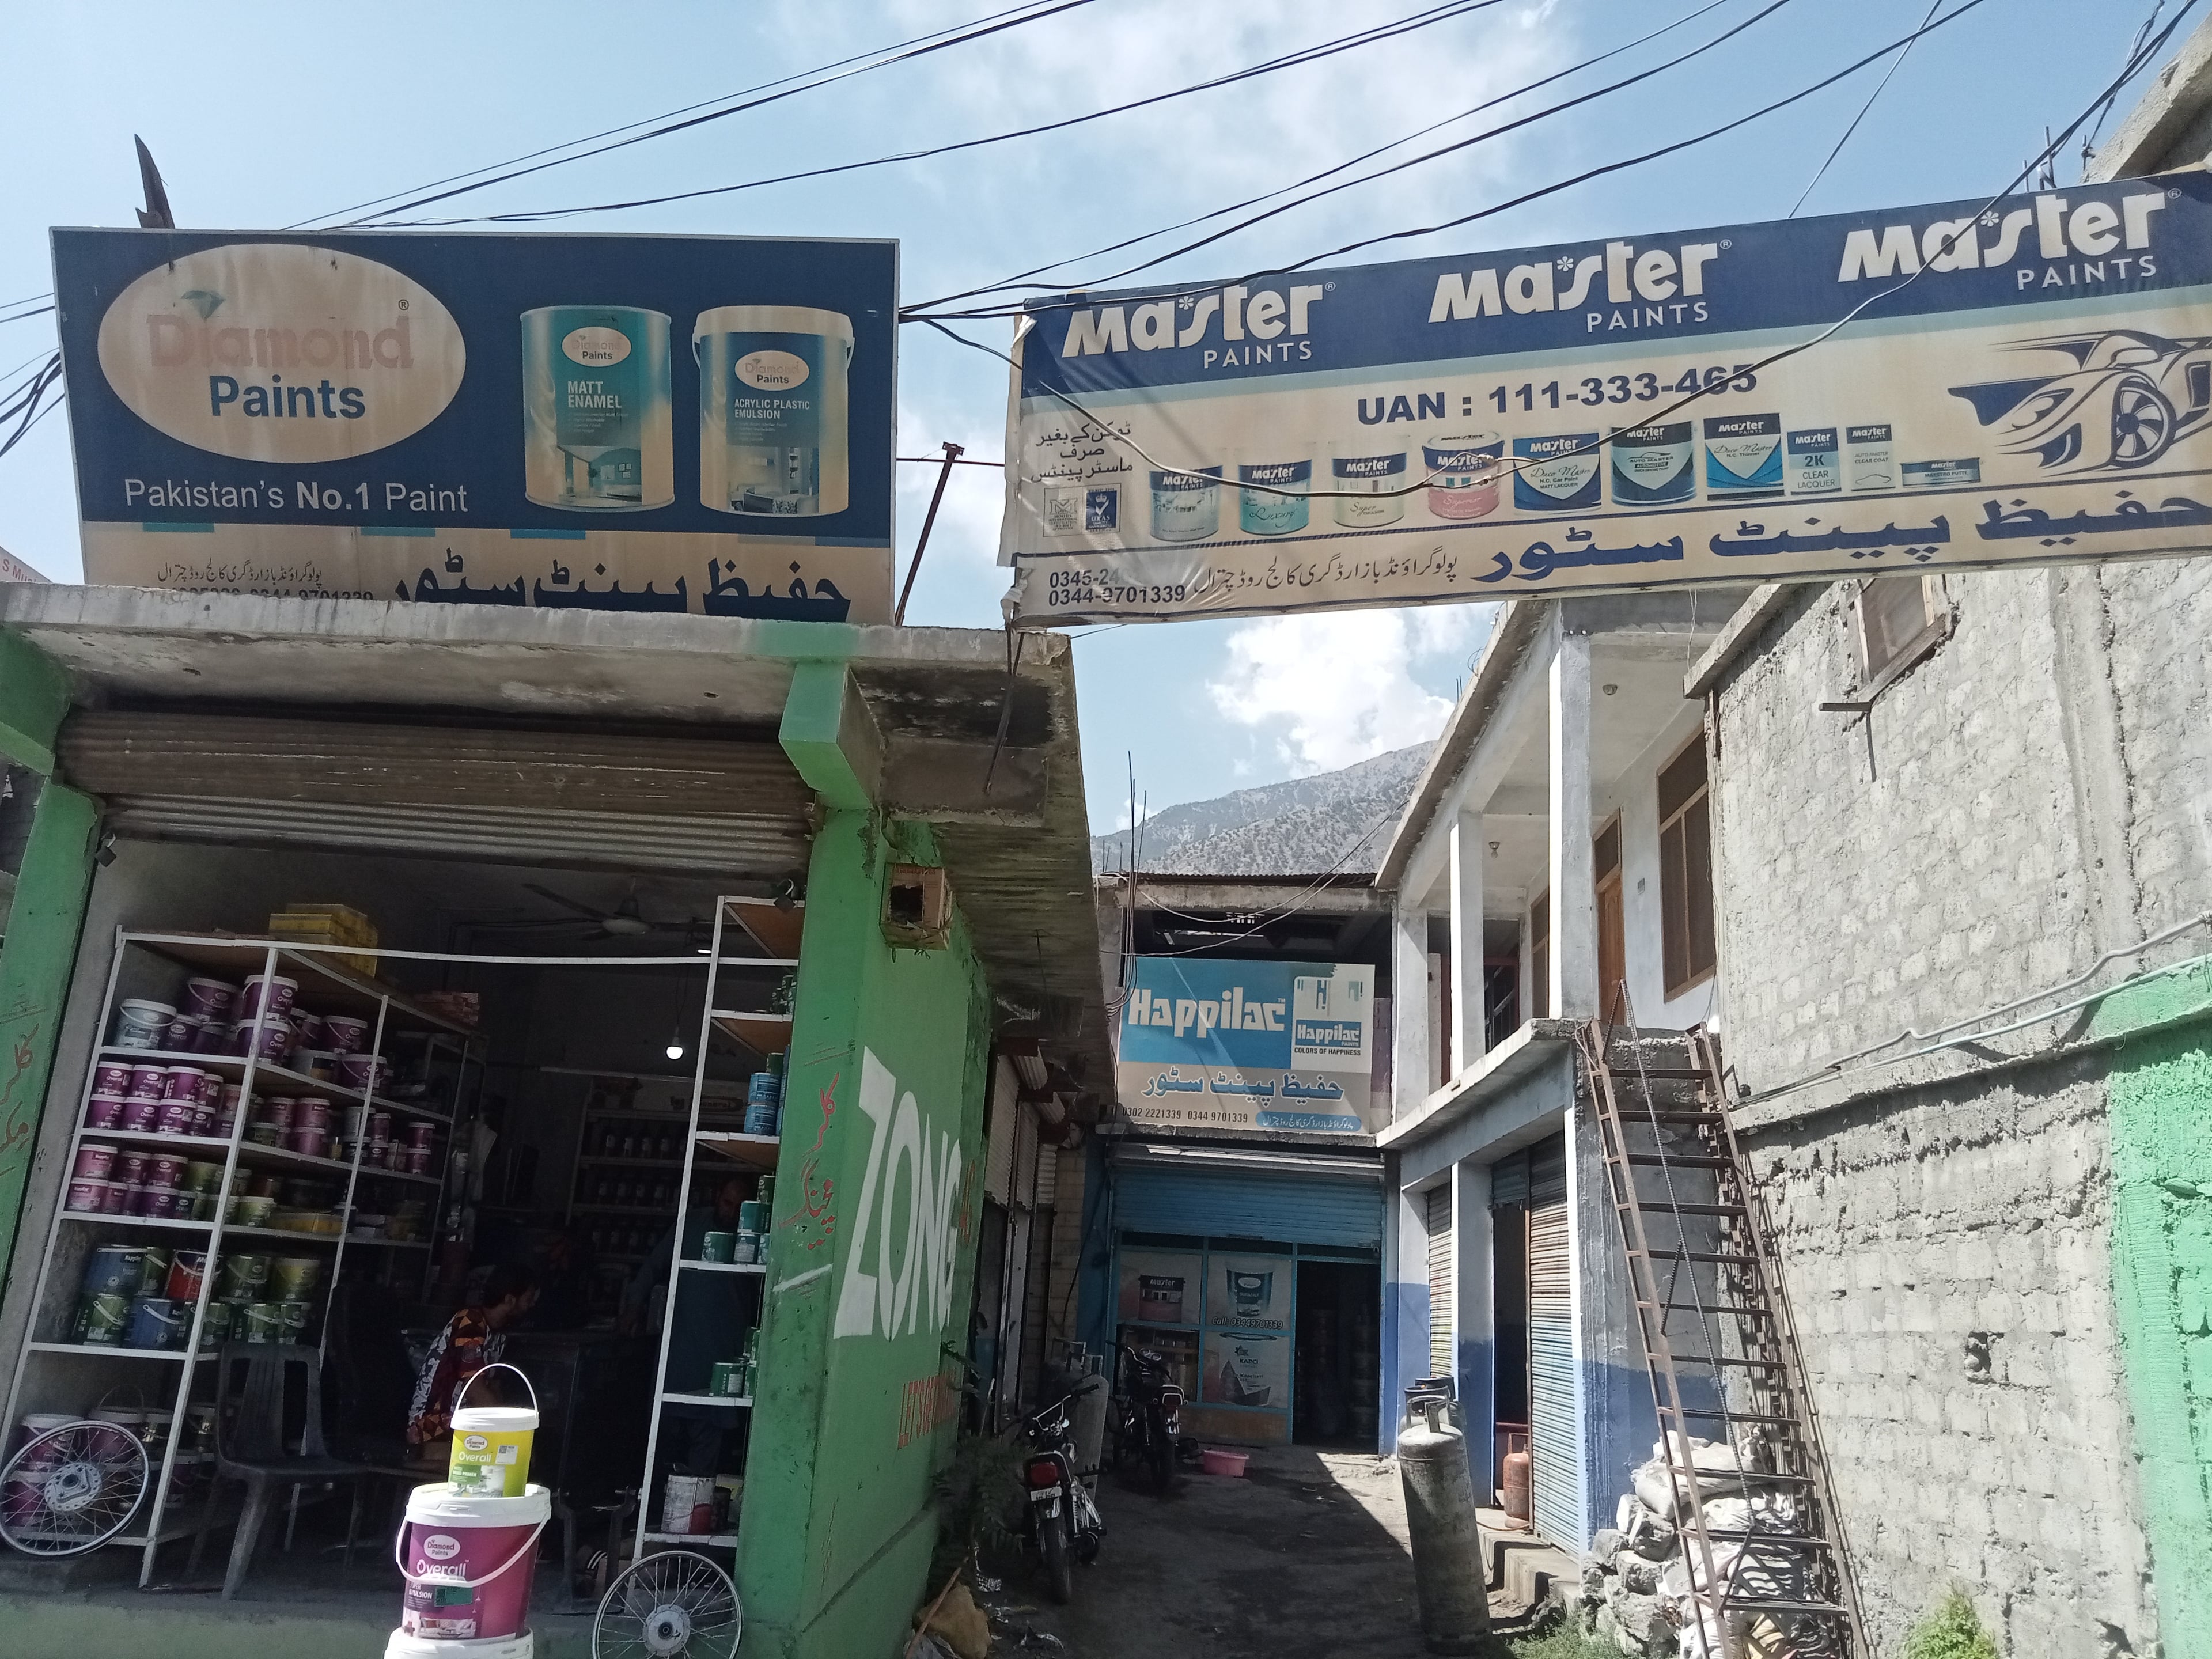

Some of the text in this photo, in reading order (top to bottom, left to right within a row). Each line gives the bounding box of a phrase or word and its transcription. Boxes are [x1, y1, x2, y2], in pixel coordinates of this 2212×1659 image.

[1838, 192, 2165, 282] Master
[2018, 256, 2157, 290] PAINTS
[1428, 241, 1718, 324] Master
[1062, 283, 1323, 358] Master
[1587, 302, 1709, 333] PAINTS
[146, 314, 414, 369] Diamond
[582, 351, 613, 360] Paints
[1203, 341, 1313, 369] PAINTS
[757, 374, 790, 384] Paints
[567, 380, 604, 395] MATT
[1357, 391, 1446, 426] UAN
[1488, 363, 1758, 414] 111-333-465
[209, 374, 366, 419] Paints
[568, 395, 622, 408] ENAMEL
[734, 399, 810, 410] ACRYLIC PLASTIC
[734, 409, 781, 419] EMULSION
[1627, 427, 1665, 438] Master
[1718, 421, 1764, 433] Master
[1852, 427, 1887, 437] Master
[1036, 428, 1068, 446] بغیر
[1795, 433, 1831, 444] Master
[1060, 444, 1105, 461] صرف
[1530, 438, 1578, 453] Master
[1085, 456, 1133, 478] ماسٹر
[1346, 459, 1389, 472] Master
[1457, 463, 1483, 471] PAINTS
[1804, 454, 1825, 468] 2K
[1252, 466, 1295, 480] Master
[1802, 470, 1829, 479] CLEAR
[1797, 478, 1835, 489] LACQUER
[297, 481, 373, 510] No.1
[385, 482, 468, 512] Paint
[1249, 506, 1297, 528] Luxury
[1350, 502, 1376, 517] Super
[1471, 490, 2212, 584] حفیظ پینٹ سٹور
[1048, 585, 1185, 607] 0344-9701339
[1128, 986, 1286, 1039] Happilac
[1297, 1024, 1359, 1044] Happilac
[1142, 1066, 1344, 1108] حفیظ پینٹ سٹور
[1122, 1107, 1248, 1123] 0302 2221339 0344 9701339
[833, 1045, 962, 1342] ZONG
[1230, 1317, 1283, 1330] 03449701339
[459, 1451, 491, 1463] Overall
[427, 1541, 455, 1550] Diamond
[416, 1559, 466, 1577] Overall
